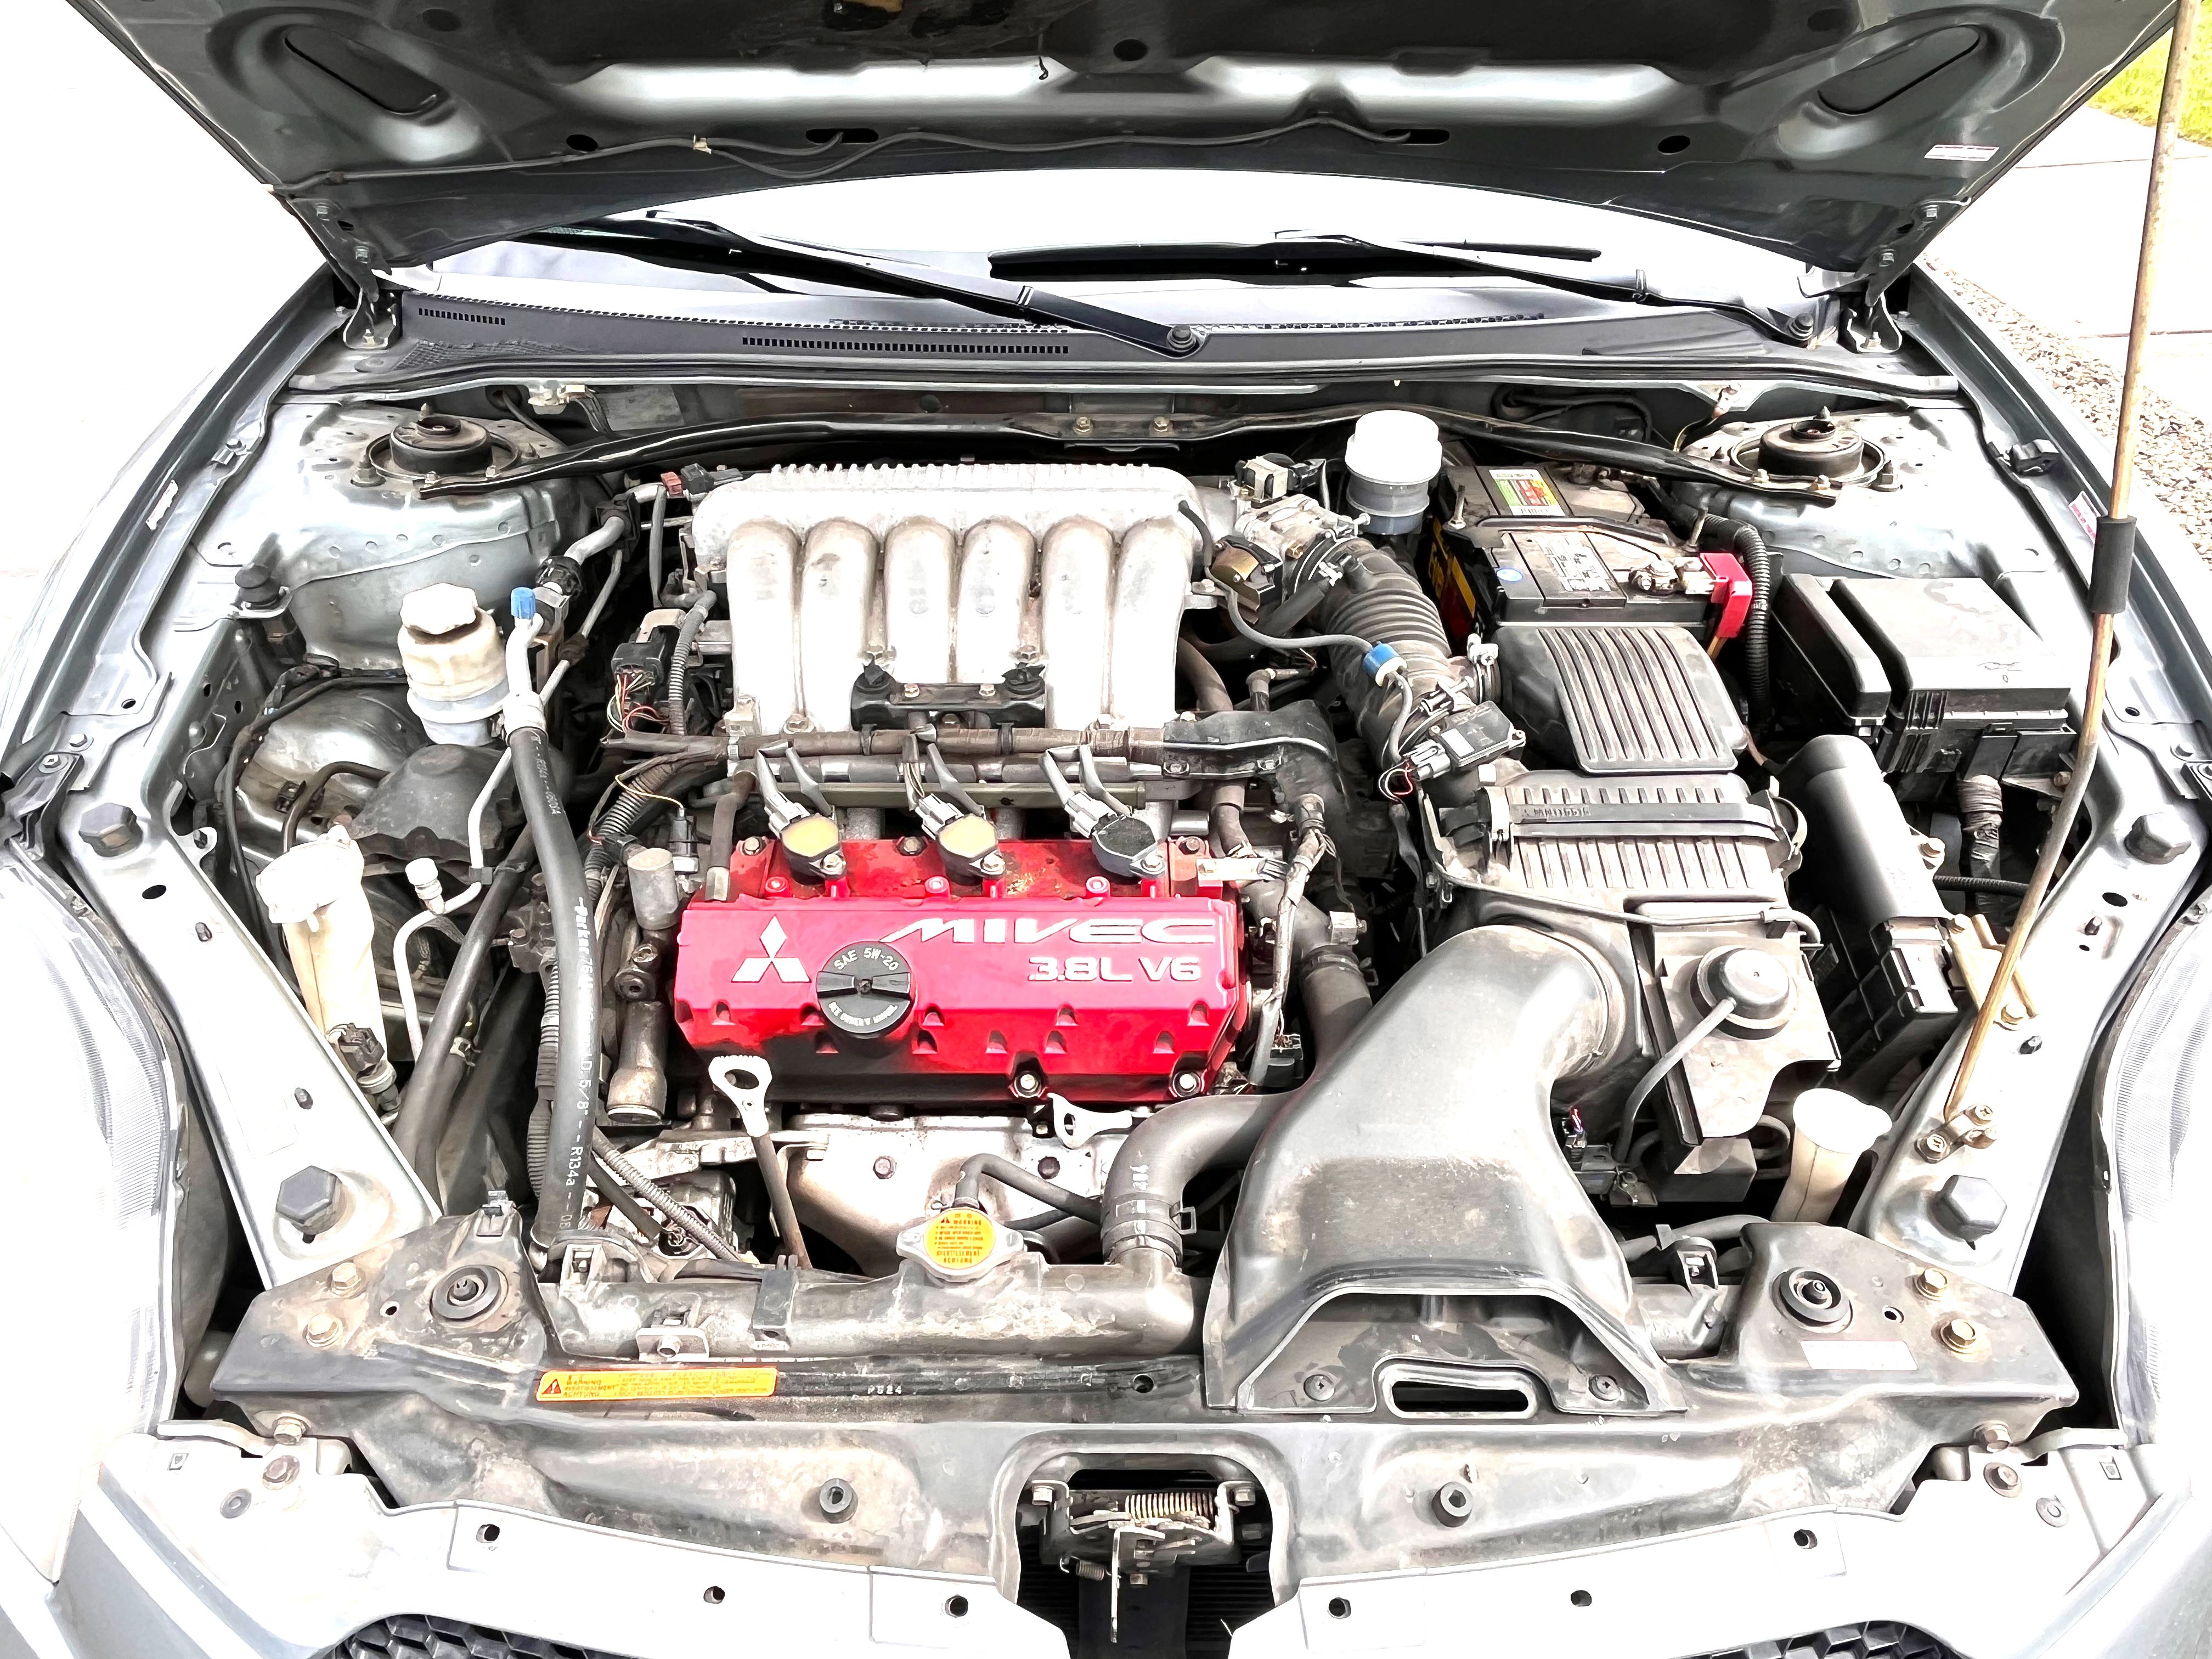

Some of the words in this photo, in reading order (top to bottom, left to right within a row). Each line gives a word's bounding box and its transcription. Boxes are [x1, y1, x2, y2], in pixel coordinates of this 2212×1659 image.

[879, 918, 1216, 944] MIVEC
[834, 950, 858, 970] SAE
[864, 947, 899, 970] 5W-20
[1028, 956, 1133, 982] 3.8L
[1138, 956, 1202, 982] V6
[566, 1146, 583, 1187] R134a
